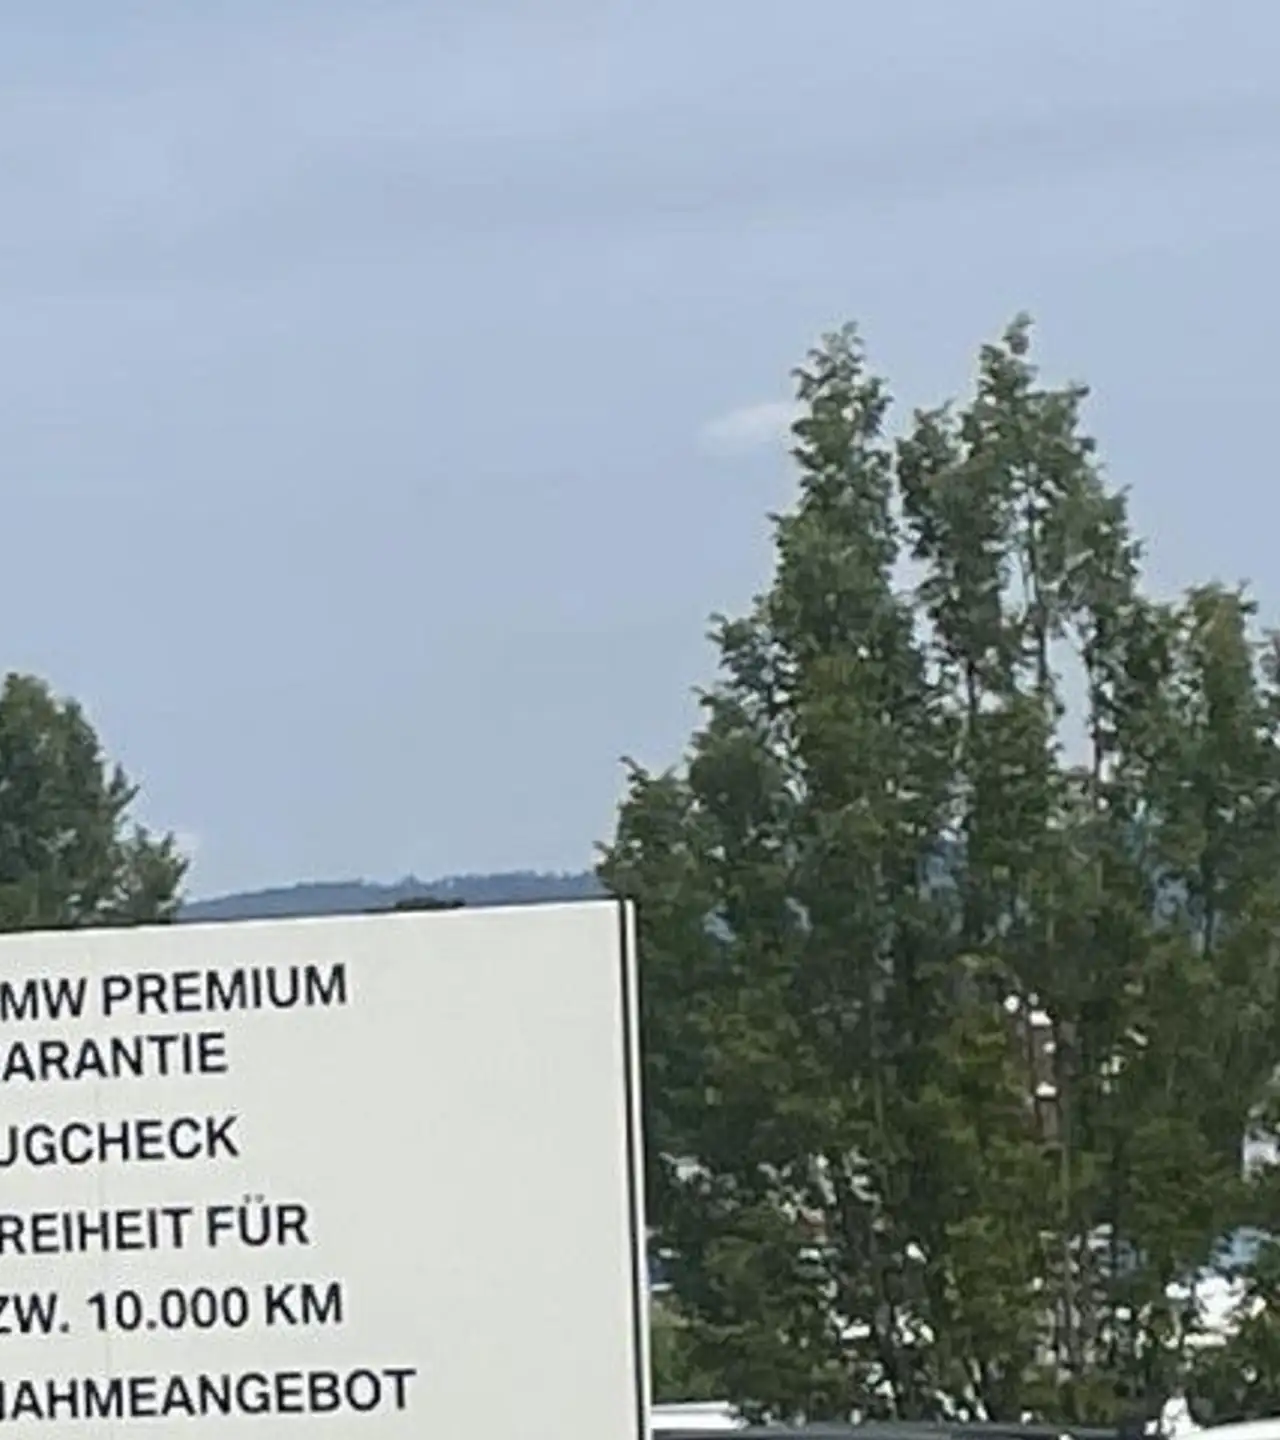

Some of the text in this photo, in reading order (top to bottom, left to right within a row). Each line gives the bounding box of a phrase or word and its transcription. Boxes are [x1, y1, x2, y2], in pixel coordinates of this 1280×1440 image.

[102, 963, 346, 1017] PREMIUM
[206, 1193, 309, 1247] FÜR
[87, 1286, 249, 1331] 10.000
[265, 1281, 343, 1326] KM
